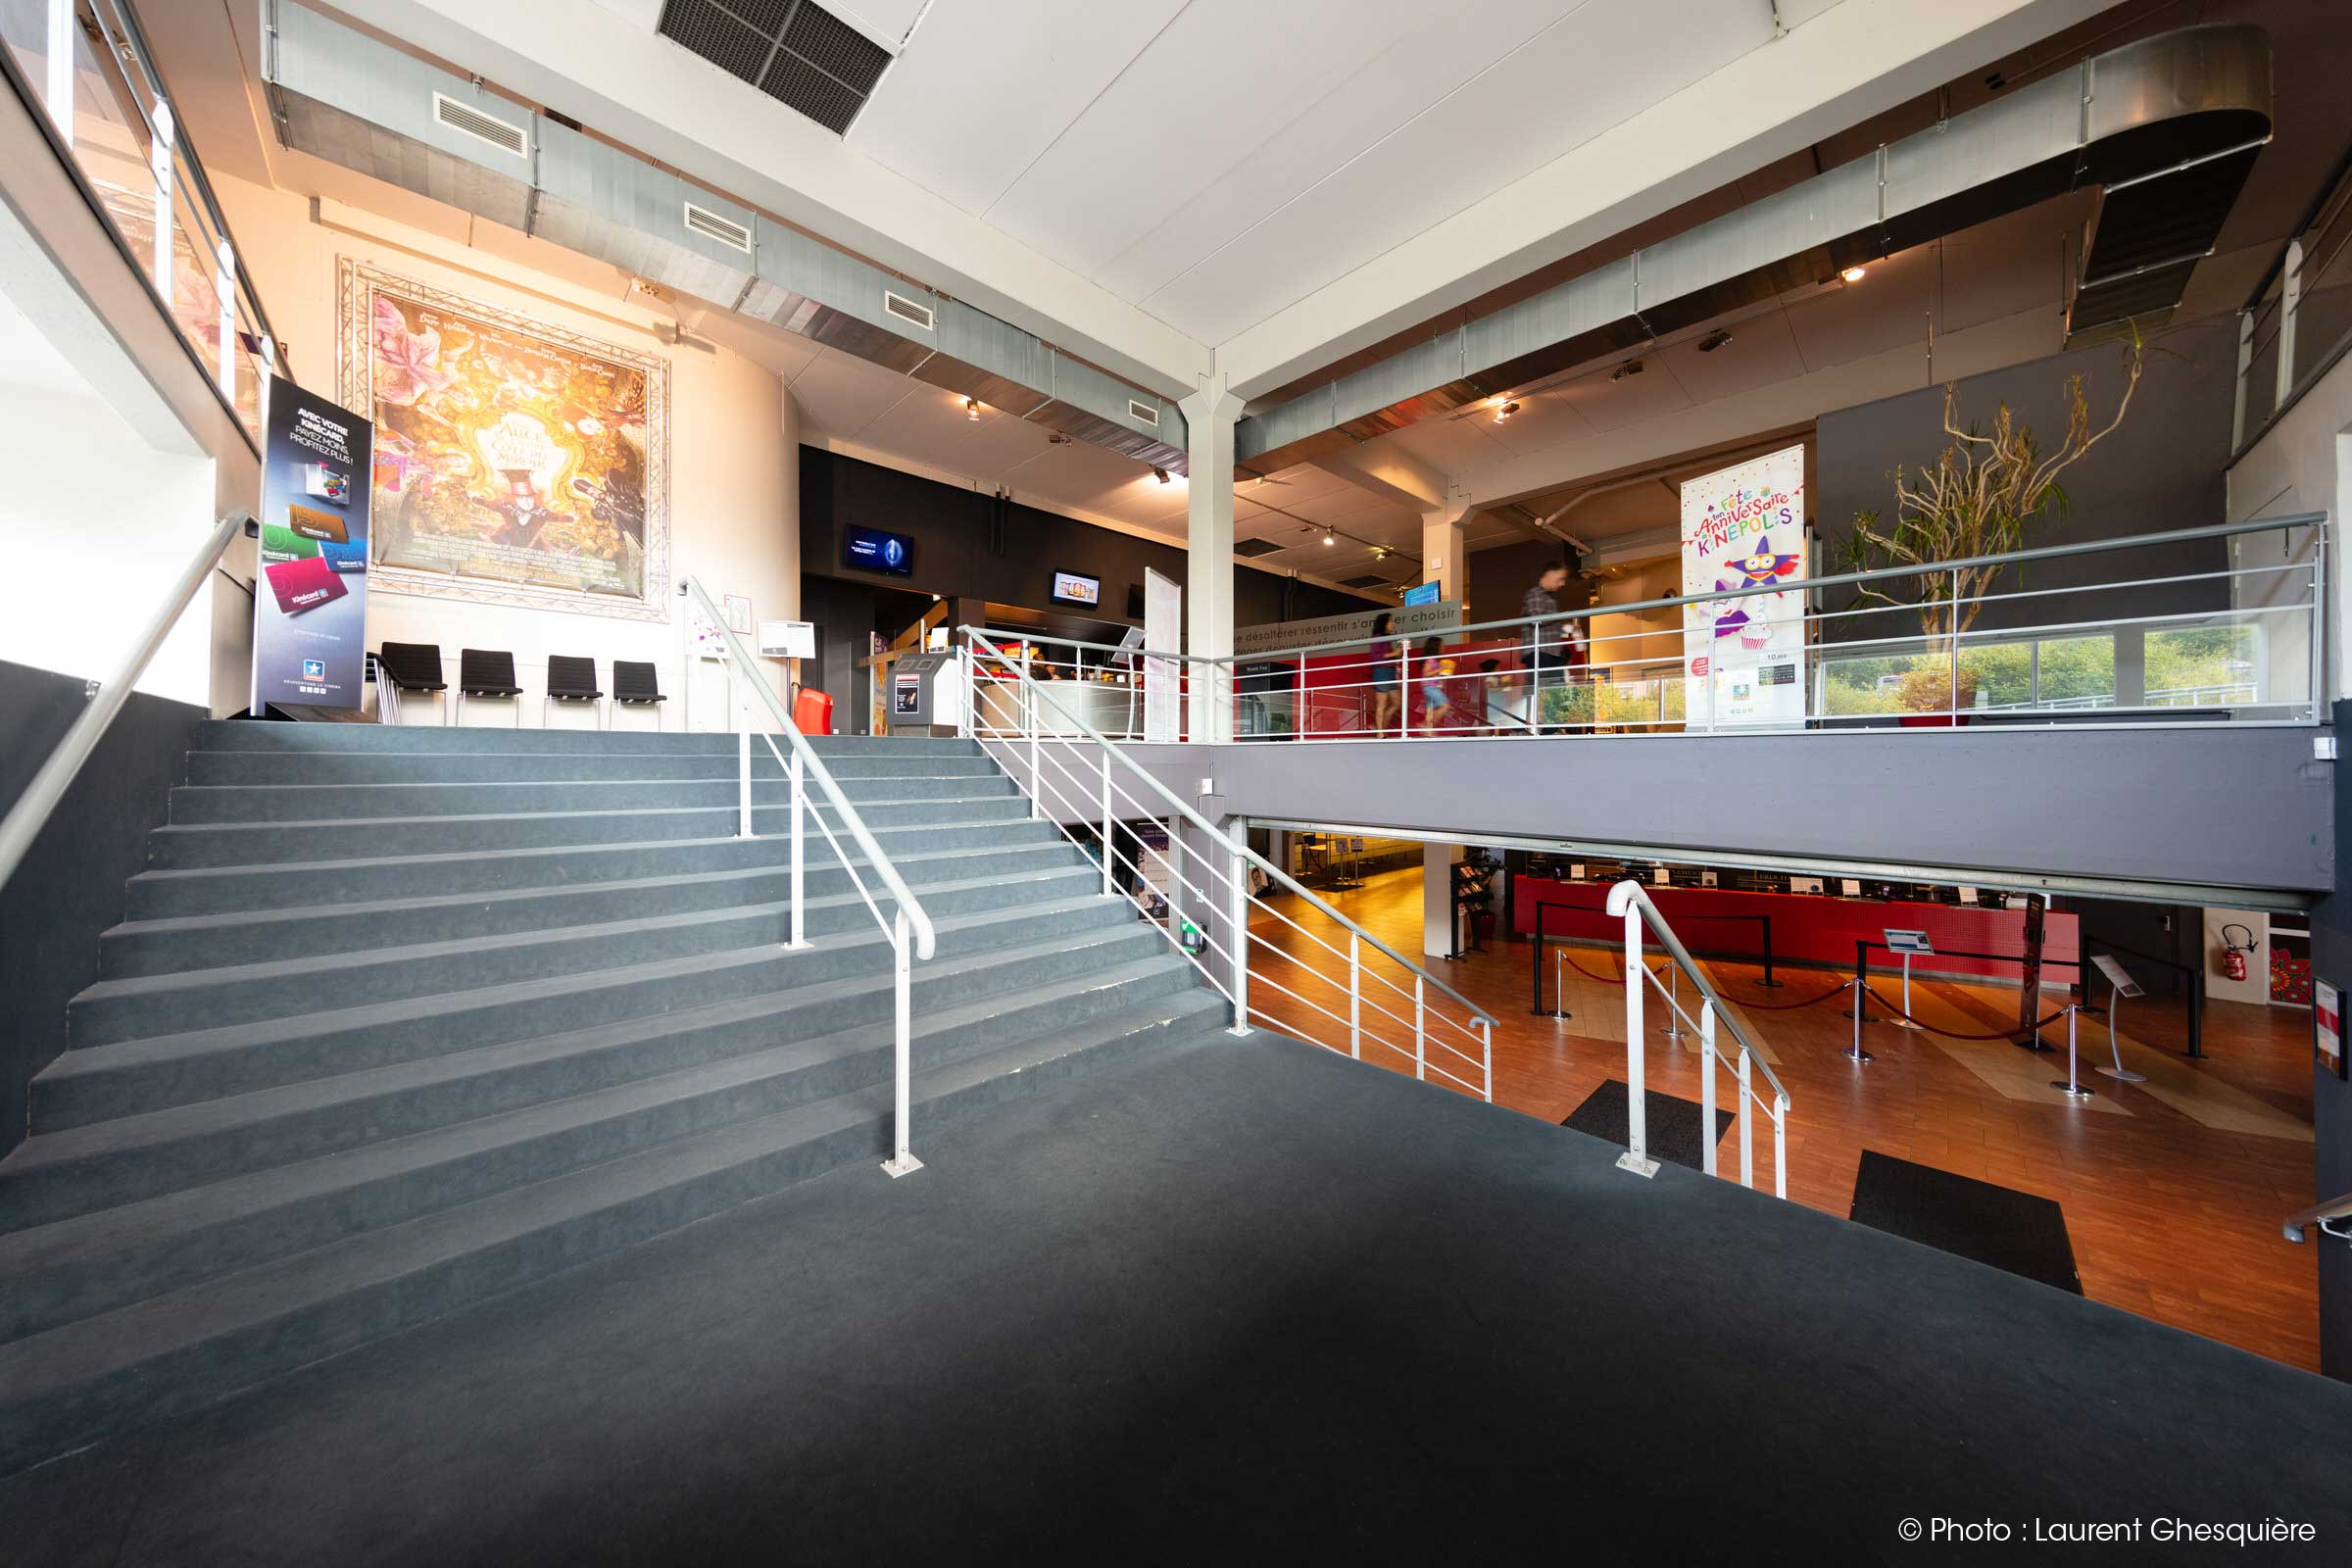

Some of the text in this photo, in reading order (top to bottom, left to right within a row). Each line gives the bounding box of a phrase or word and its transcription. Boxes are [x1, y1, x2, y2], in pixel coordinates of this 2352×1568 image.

[295, 425, 321, 443] PAYEZ
[297, 408, 349, 436] AVEC VOTRE
[301, 417, 345, 444] KINÉCARD,
[289, 432, 330, 456] PROFITEZ
[1721, 489, 1753, 511] Fête
[1712, 511, 1726, 521] ton
[1300, 621, 1349, 636] ressentir
[1411, 608, 1455, 623] choisir
